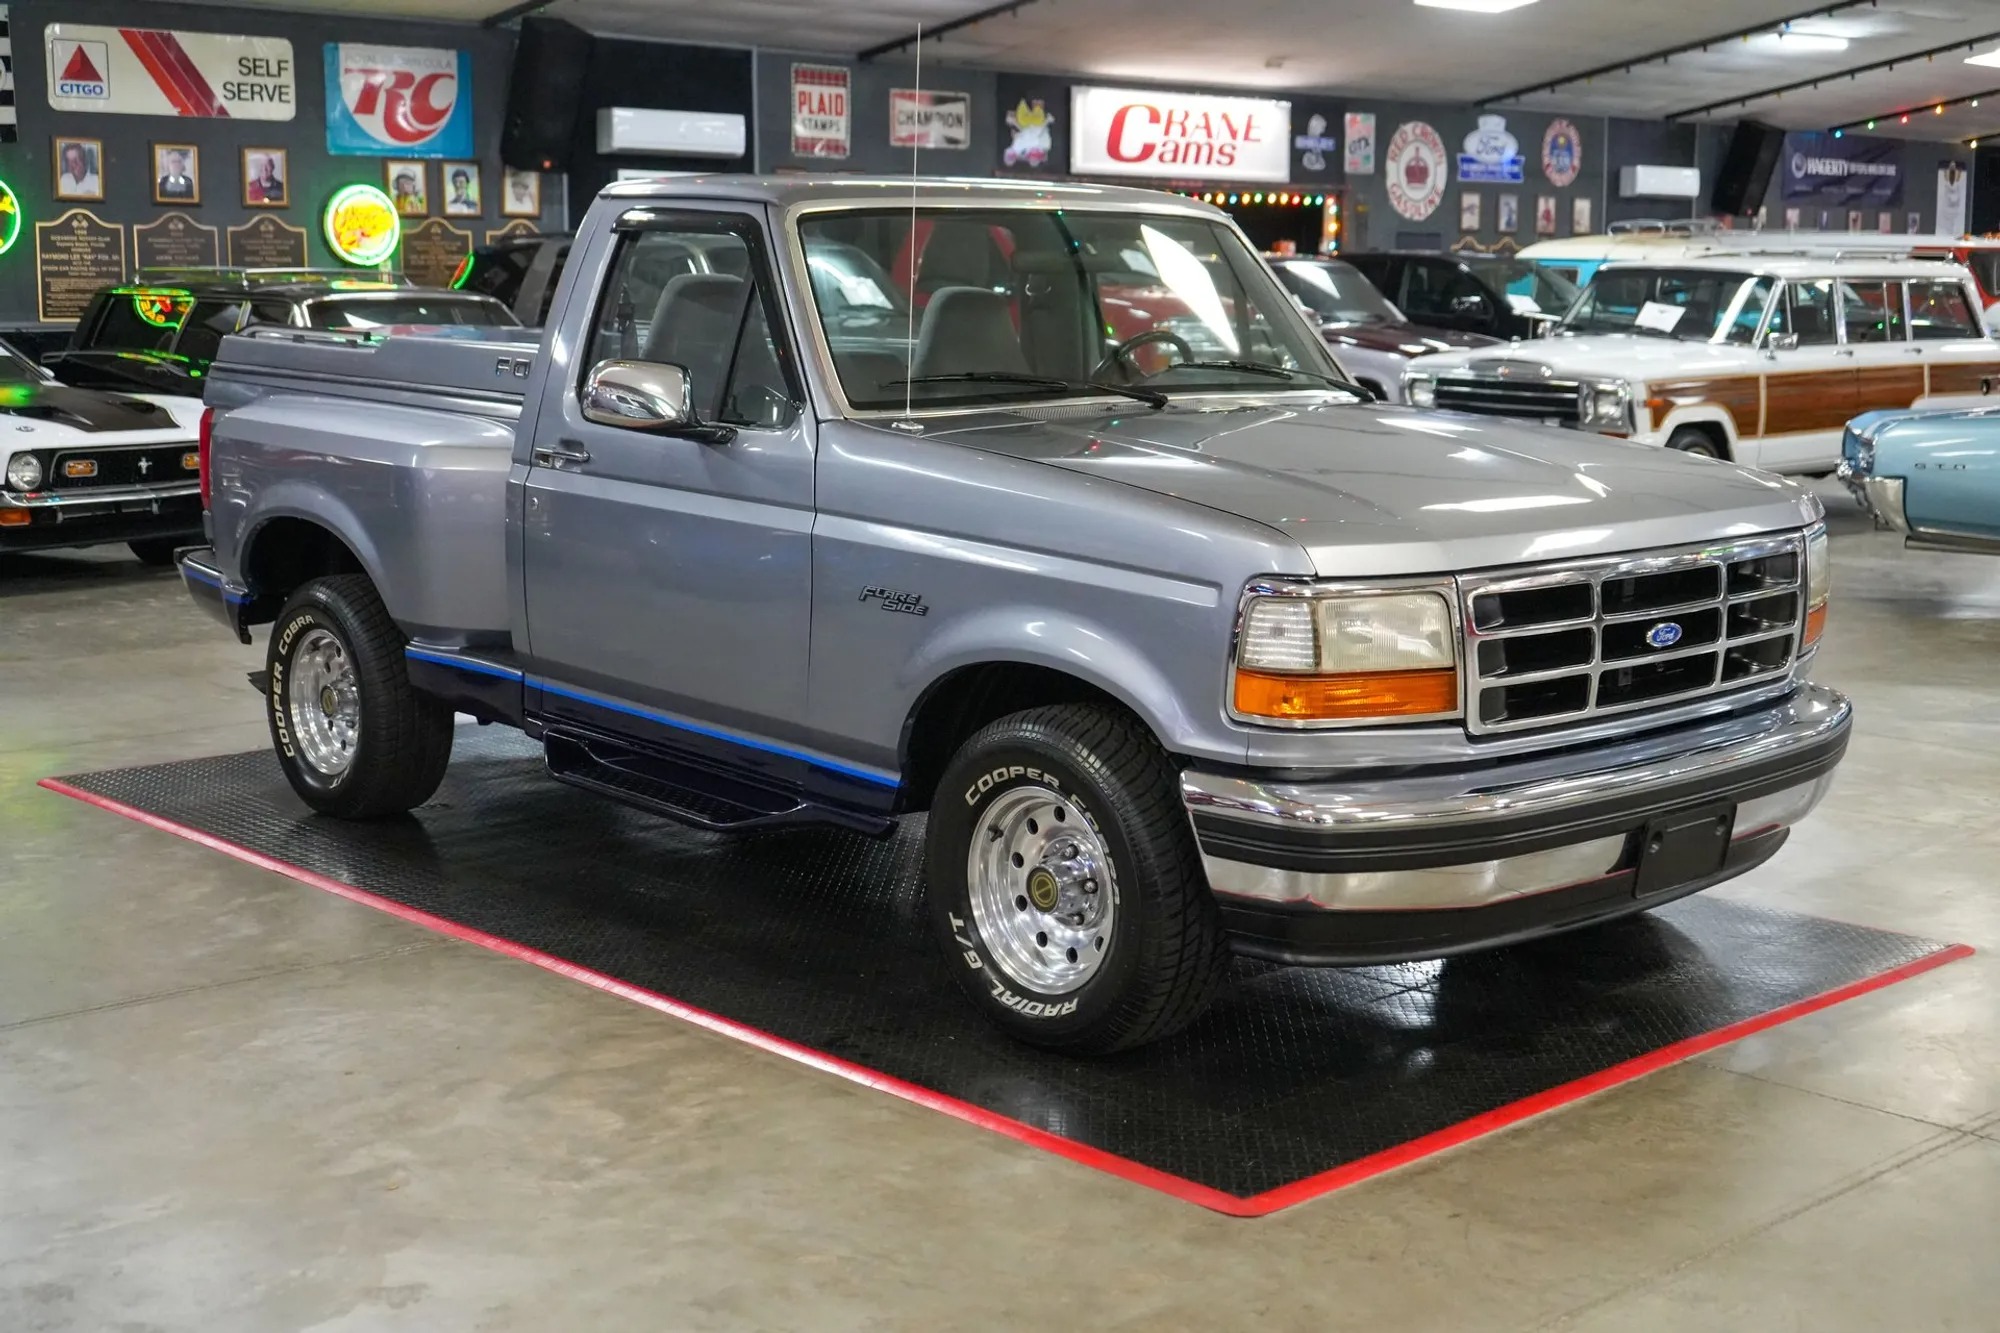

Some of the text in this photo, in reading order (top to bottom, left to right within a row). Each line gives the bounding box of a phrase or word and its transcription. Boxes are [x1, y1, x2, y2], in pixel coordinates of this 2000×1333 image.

[238, 57, 290, 79] SELF
[60, 83, 104, 96] CITGO
[222, 81, 291, 104] SERVE
[344, 68, 456, 144] RC
[798, 91, 844, 117] PLAID
[803, 118, 840, 132] STAMPS
[1106, 104, 1261, 163] CRANE
[1807, 157, 1849, 176] HAGERTY
[859, 585, 922, 602] FLARE
[881, 599, 930, 616] SIDE
[273, 614, 315, 758] COOPER COBRA
[964, 766, 1061, 806] COOPER
[948, 911, 1079, 1018] RADIAL G/T
